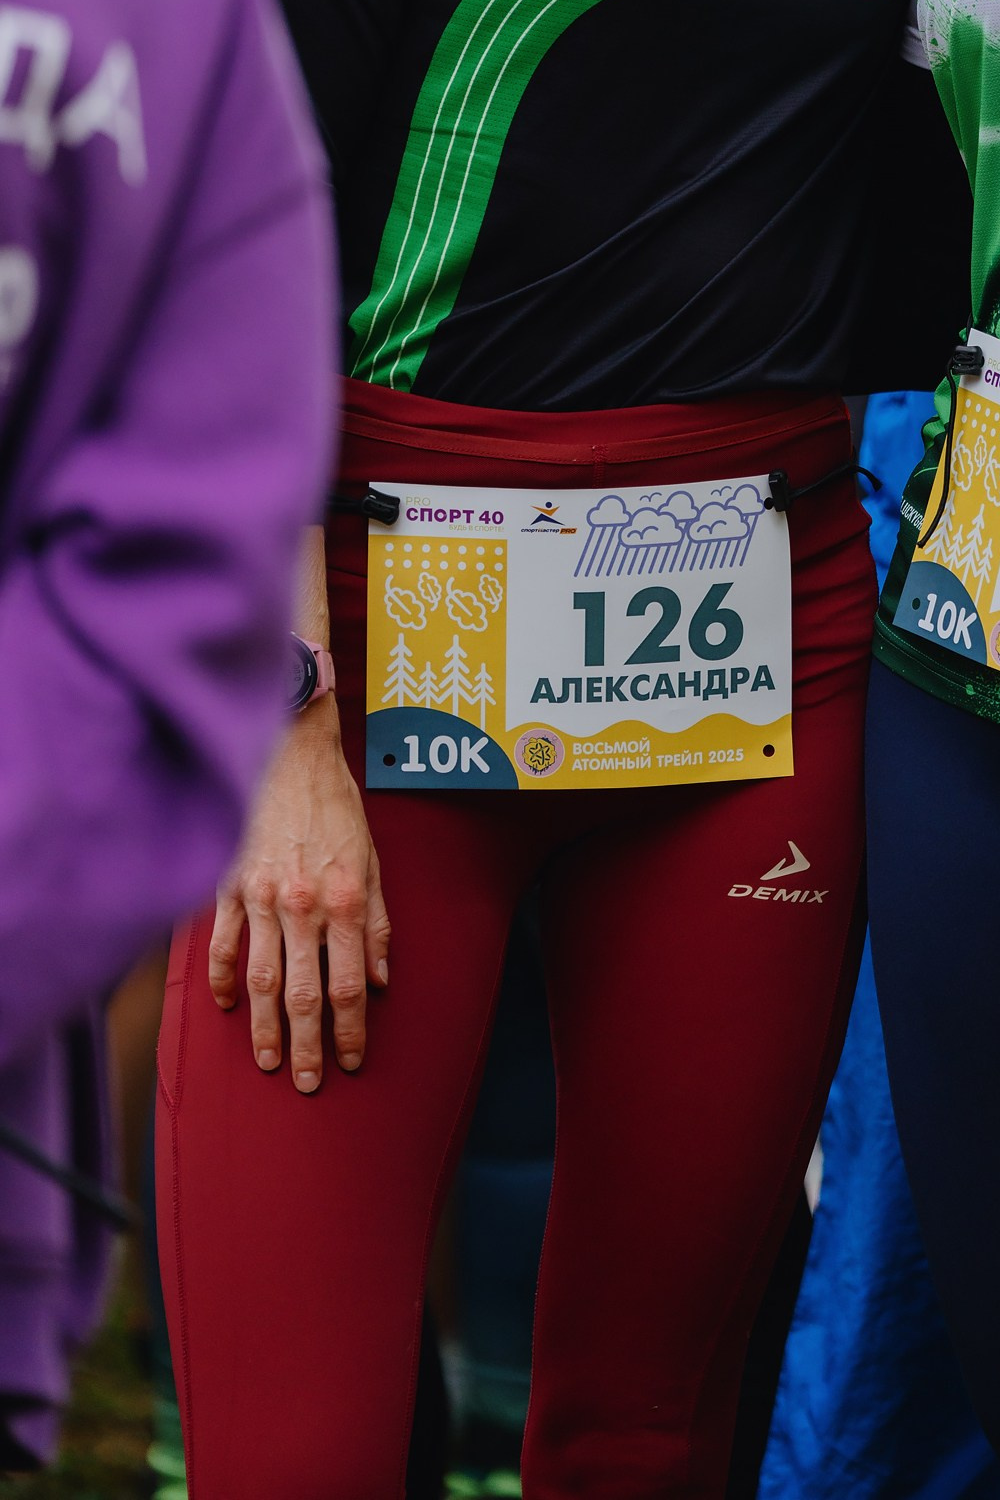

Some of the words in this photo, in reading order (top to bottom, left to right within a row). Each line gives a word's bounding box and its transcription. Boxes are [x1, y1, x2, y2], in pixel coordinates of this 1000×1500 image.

[406, 497, 431, 506] PRO
[406, 508, 474, 523] СПОРТ
[478, 511, 504, 524] 40
[573, 582, 744, 668] 126
[530, 664, 776, 704] АЛЕКСАНДРА
[572, 737, 650, 755] ВОСЬМОЙ
[571, 753, 651, 771] АТОМНЫЙ
[656, 749, 703, 767] ТРЕЙЛ
[708, 748, 745, 763] 2025
[727, 884, 829, 903] DEMIX
